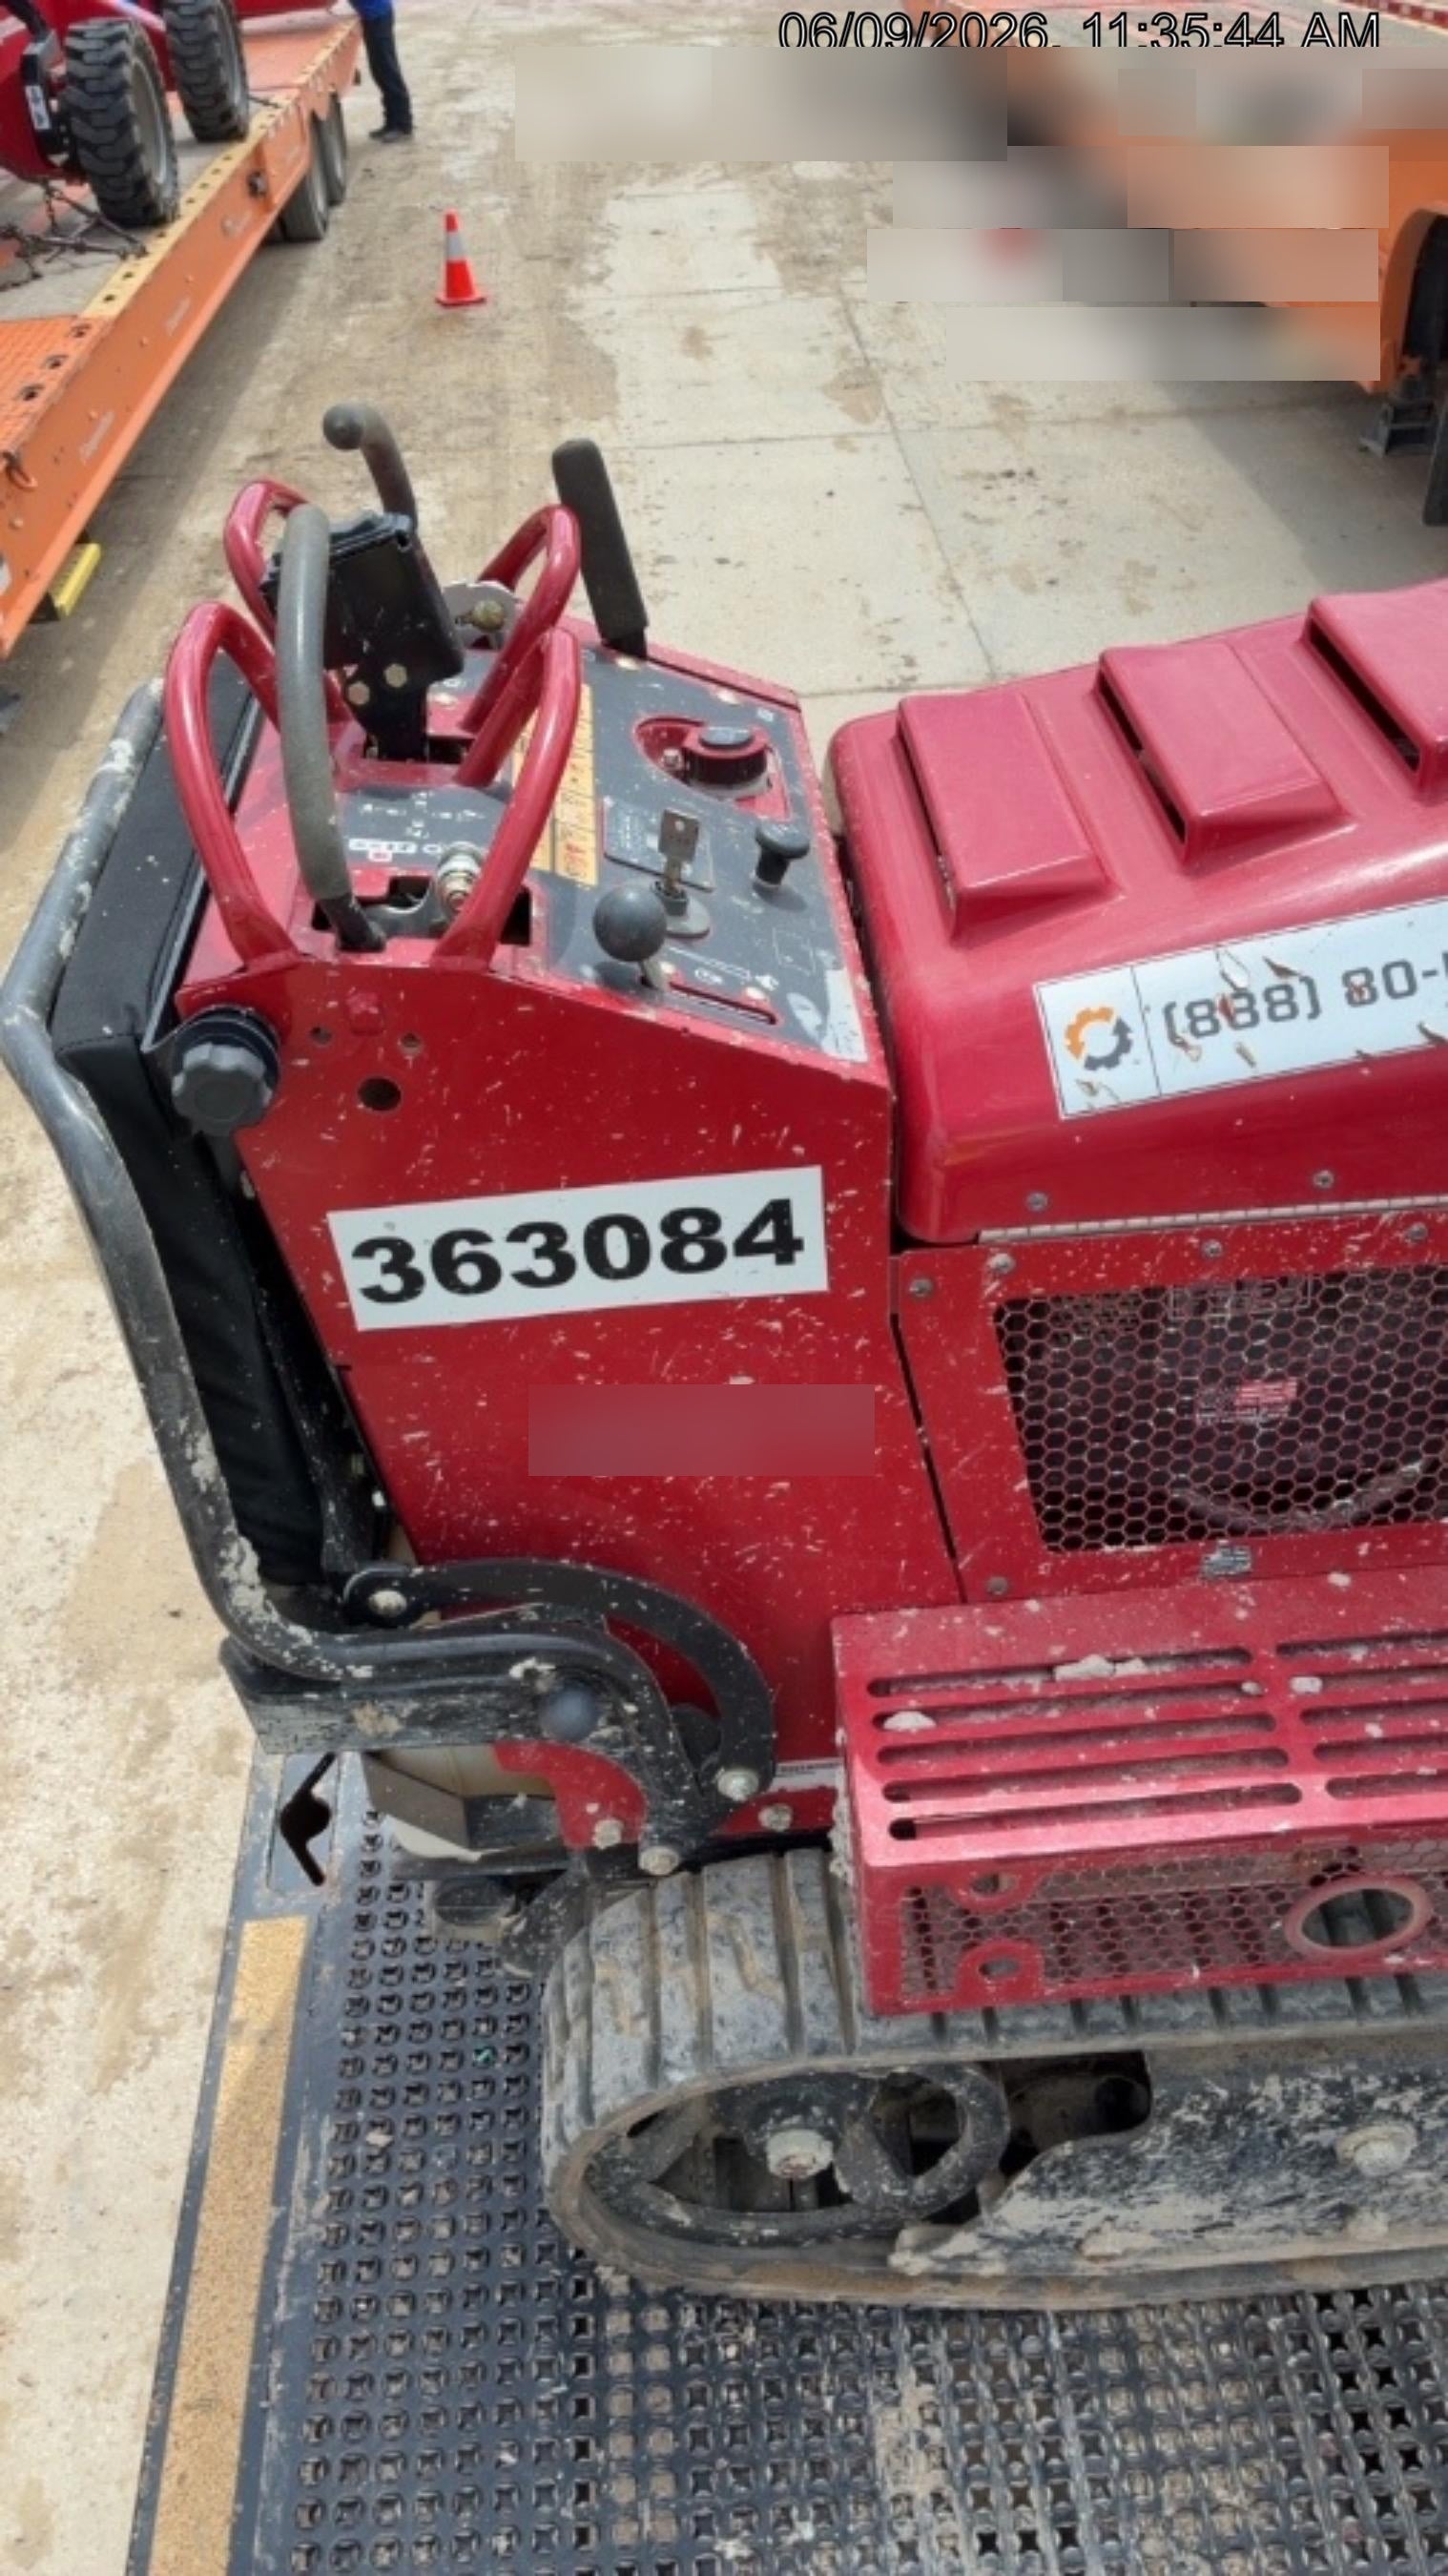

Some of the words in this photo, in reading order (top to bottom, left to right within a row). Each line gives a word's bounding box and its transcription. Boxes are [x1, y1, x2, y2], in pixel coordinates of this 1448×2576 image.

[1163, 975, 1321, 1048] (888)
[1341, 950, 1448, 1007] 80-
[351, 1197, 805, 1304] 363084
